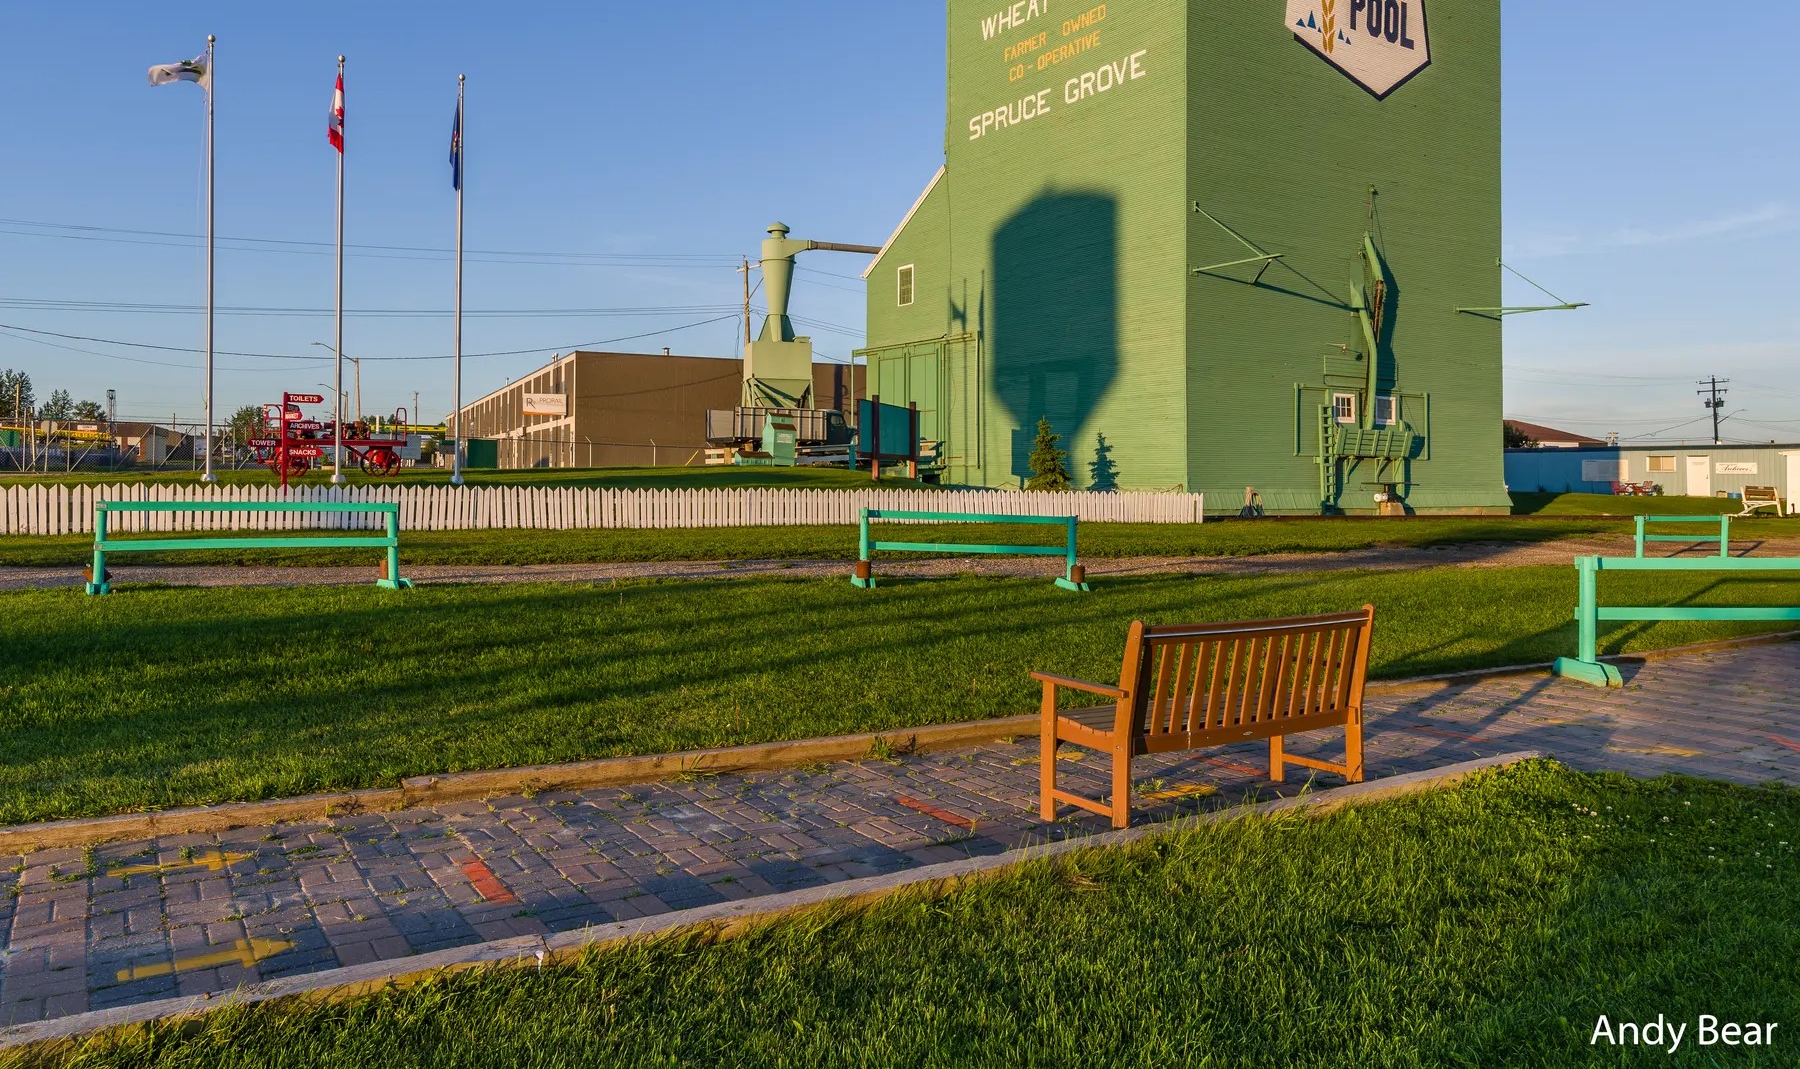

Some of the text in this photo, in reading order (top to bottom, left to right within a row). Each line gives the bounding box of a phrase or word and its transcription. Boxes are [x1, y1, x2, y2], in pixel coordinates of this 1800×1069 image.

[1004, 3, 1107, 62] FARMER OWNED
[969, 49, 1147, 141] SPRUCE GROVE
